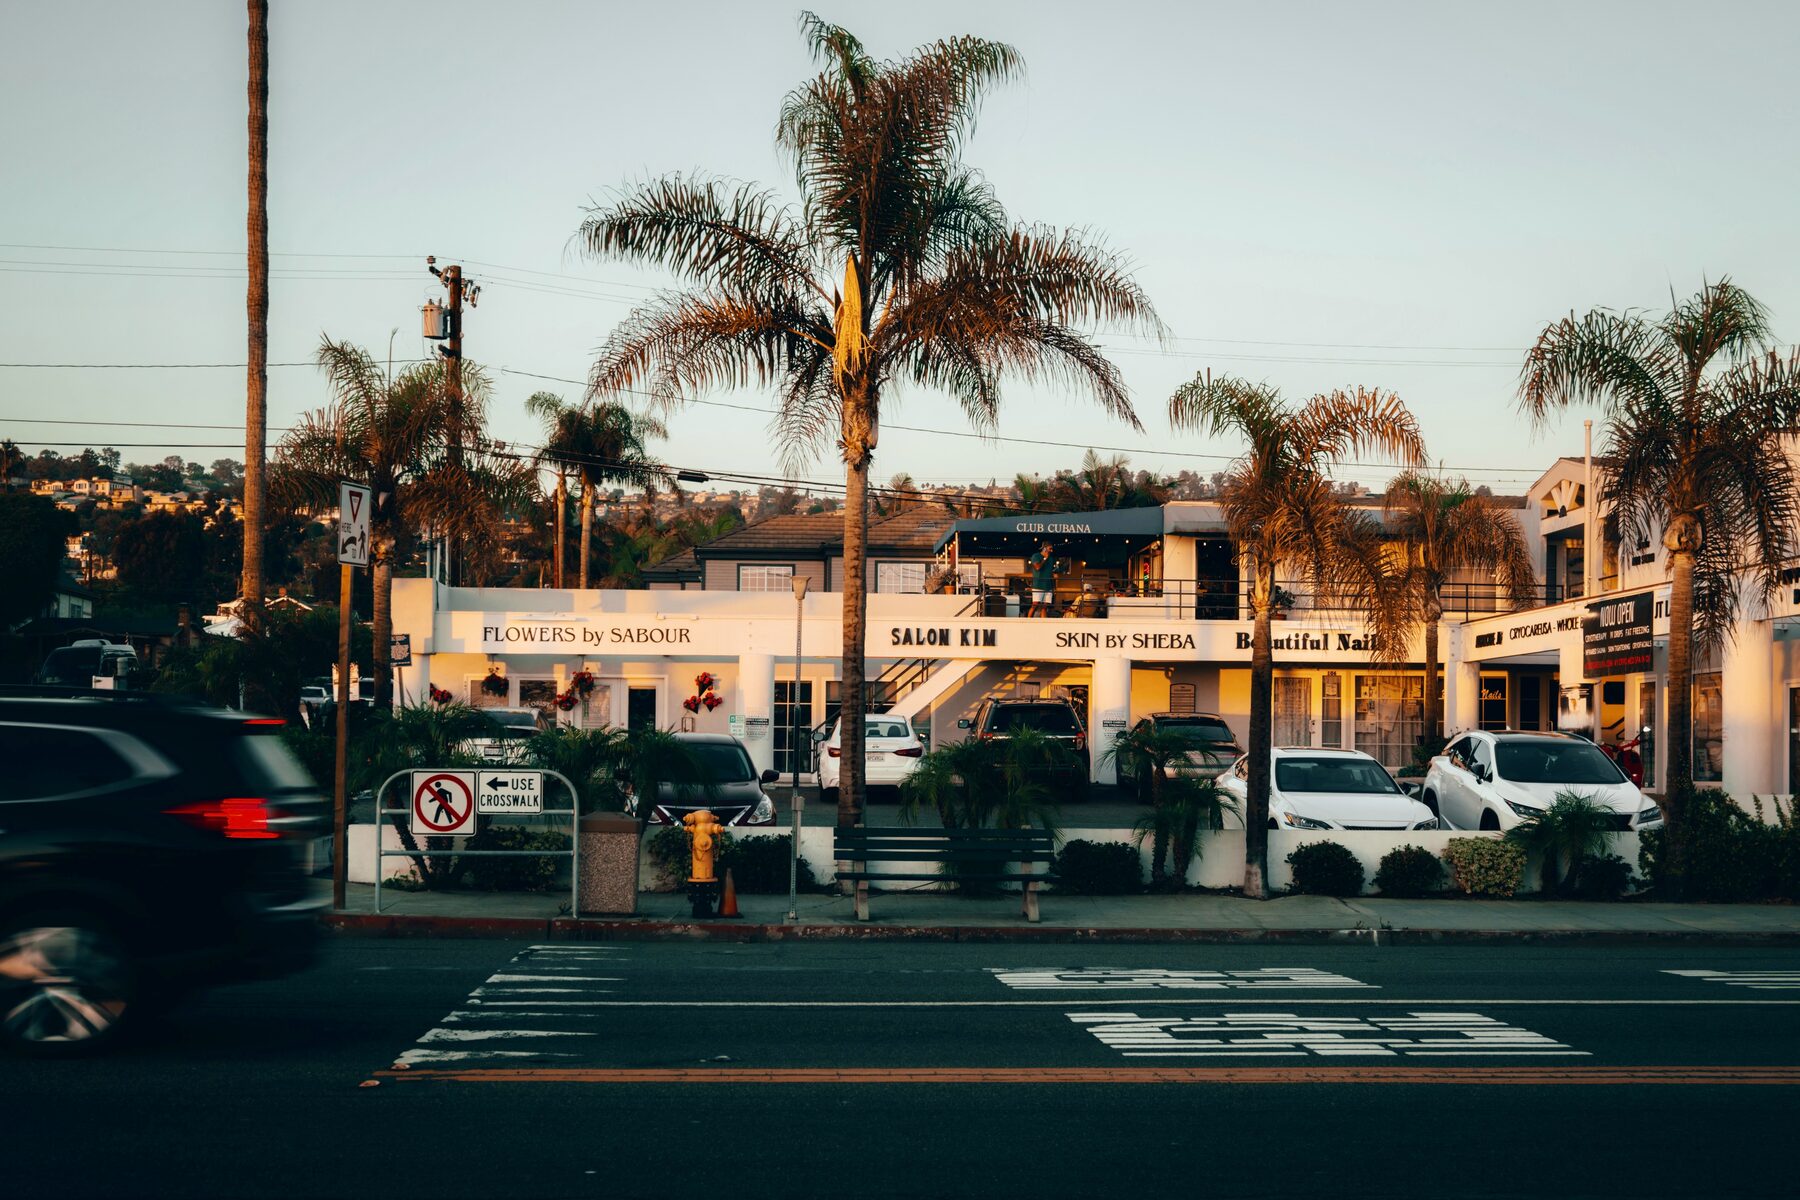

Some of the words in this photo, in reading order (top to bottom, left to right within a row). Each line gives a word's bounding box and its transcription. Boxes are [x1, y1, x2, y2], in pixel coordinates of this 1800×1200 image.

[1016, 523, 1044, 532] CLUB
[1047, 523, 1091, 533] CUBANA
[1600, 604, 1617, 627] NOW
[1617, 601, 1635, 625] OPEN
[483, 626, 576, 642] FLOWERS
[583, 627, 604, 646] by
[610, 628, 691, 643] SABOUR
[1509, 621, 1552, 640] CRYOCAREUSA
[1557, 616, 1579, 632] WHOLE
[891, 628, 950, 646] SALON
[960, 629, 997, 646] KIM
[1056, 632, 1099, 648] SKIN
[1105, 634, 1127, 648] BY
[1132, 633, 1196, 649] SHEBA
[1235, 632, 1329, 651] Butiful
[1337, 633, 1383, 651] Nail
[1481, 689, 1502, 700] Nails
[511, 778, 535, 791] USE
[480, 794, 539, 807] CROSSWALK
